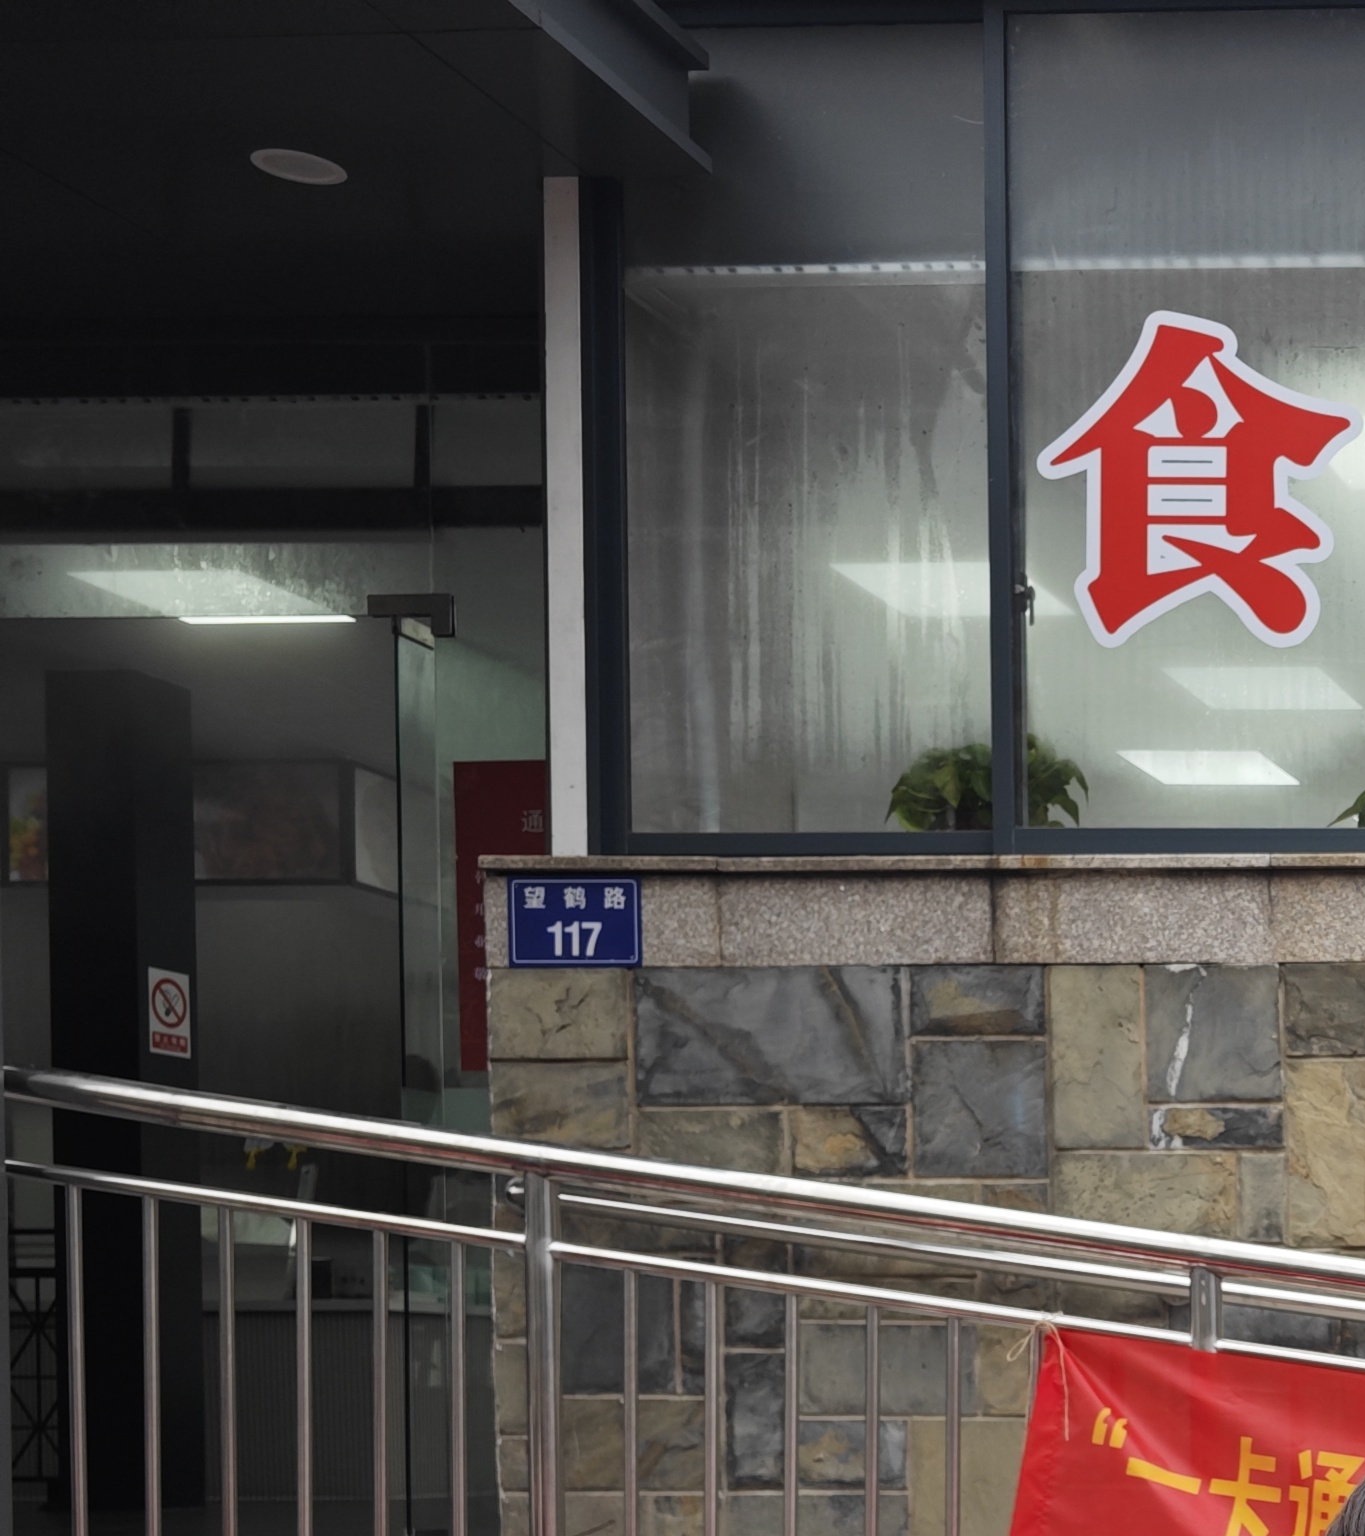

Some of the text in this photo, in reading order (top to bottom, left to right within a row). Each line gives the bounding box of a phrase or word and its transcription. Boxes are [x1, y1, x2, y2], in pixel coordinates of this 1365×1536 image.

[522, 885, 627, 911] 望鹤路
[546, 920, 603, 958] 117
